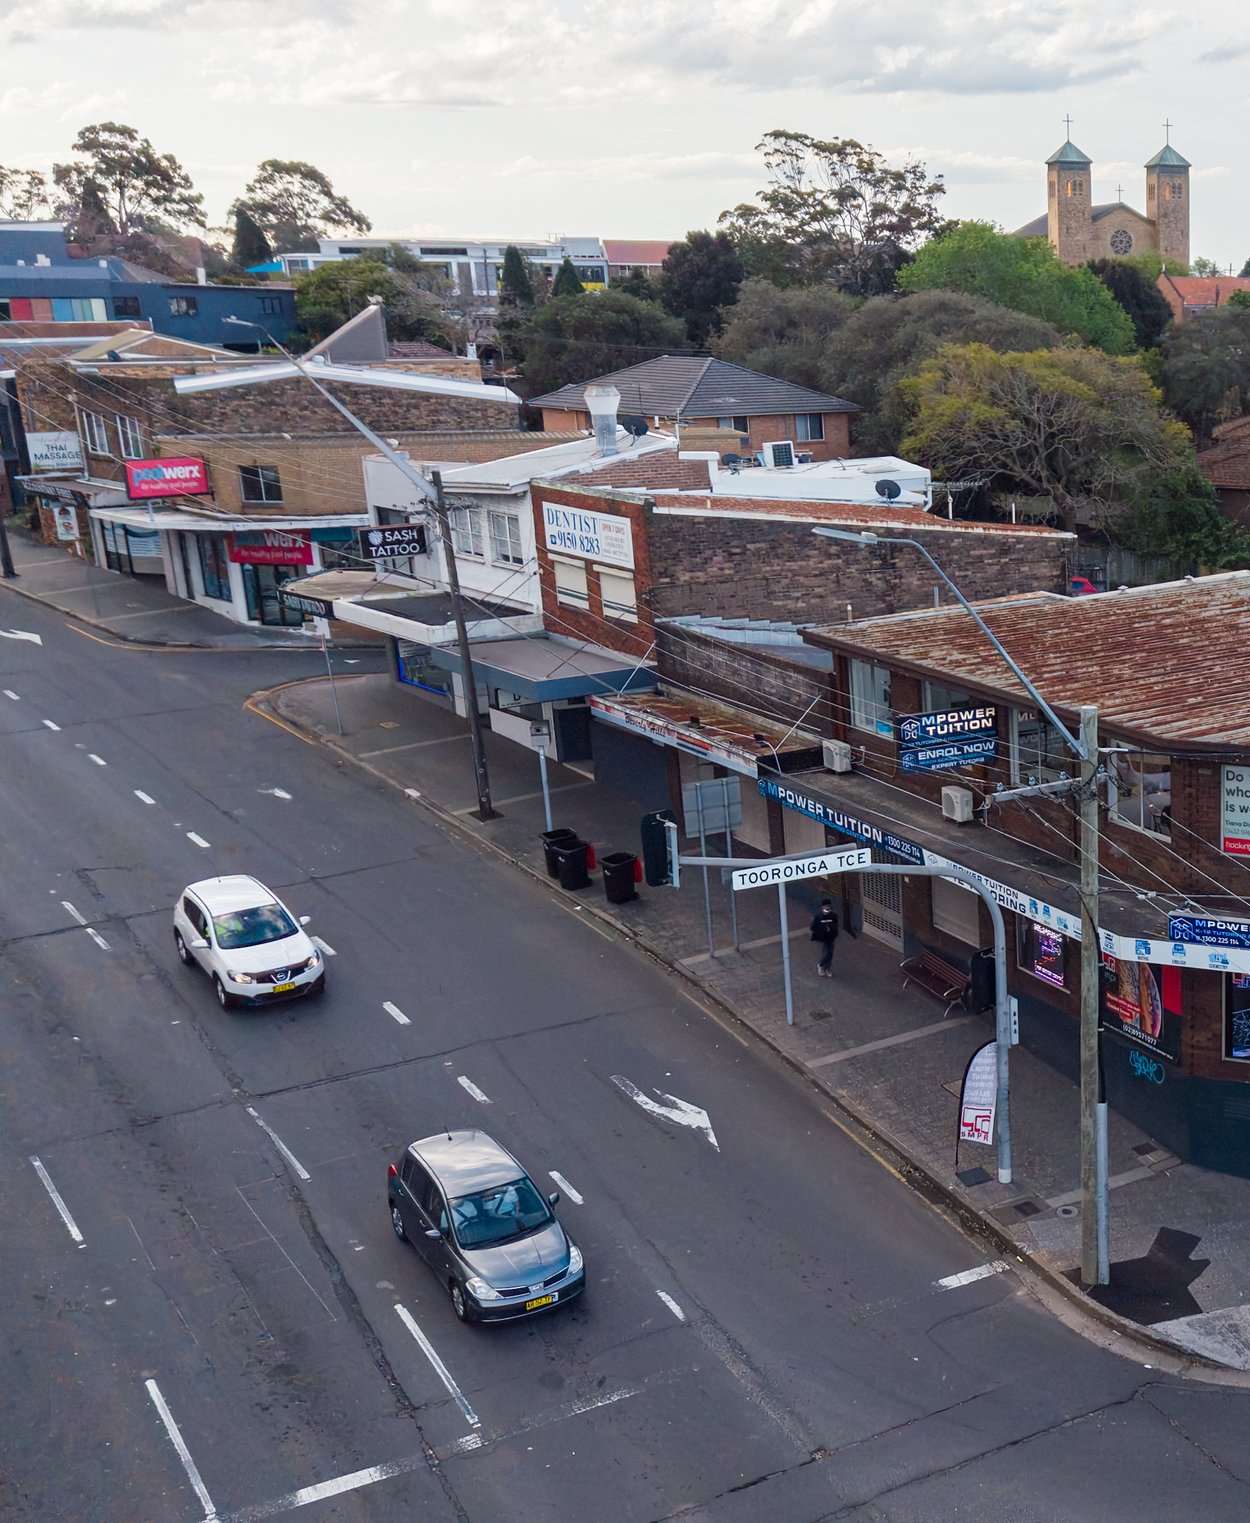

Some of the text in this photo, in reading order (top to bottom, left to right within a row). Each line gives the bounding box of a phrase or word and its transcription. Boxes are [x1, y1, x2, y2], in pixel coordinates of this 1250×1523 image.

[34, 452, 81, 462] MASSAGE
[45, 444, 67, 455] THAI
[547, 508, 597, 535] DENTIST
[384, 530, 417, 542] SASH
[557, 531, 577, 550] 9150
[580, 535, 601, 555] 8283
[370, 543, 420, 556] TATTOO
[921, 707, 996, 726] MPOWER
[926, 718, 992, 736] TUITION
[918, 742, 994, 760] ENROL NOW
[931, 757, 985, 770] EXPERT TUTORS
[1226, 769, 1244, 782] Do
[768, 782, 882, 844] MPOWER TUITION
[1225, 801, 1235, 813] is
[1225, 819, 1242, 828] Tiana
[888, 836, 920, 857] 1300 225 114
[738, 853, 866, 885] TOORONGA TCE
[984, 879, 1019, 900] TUITION
[1213, 931, 1247, 939] TUTORING
